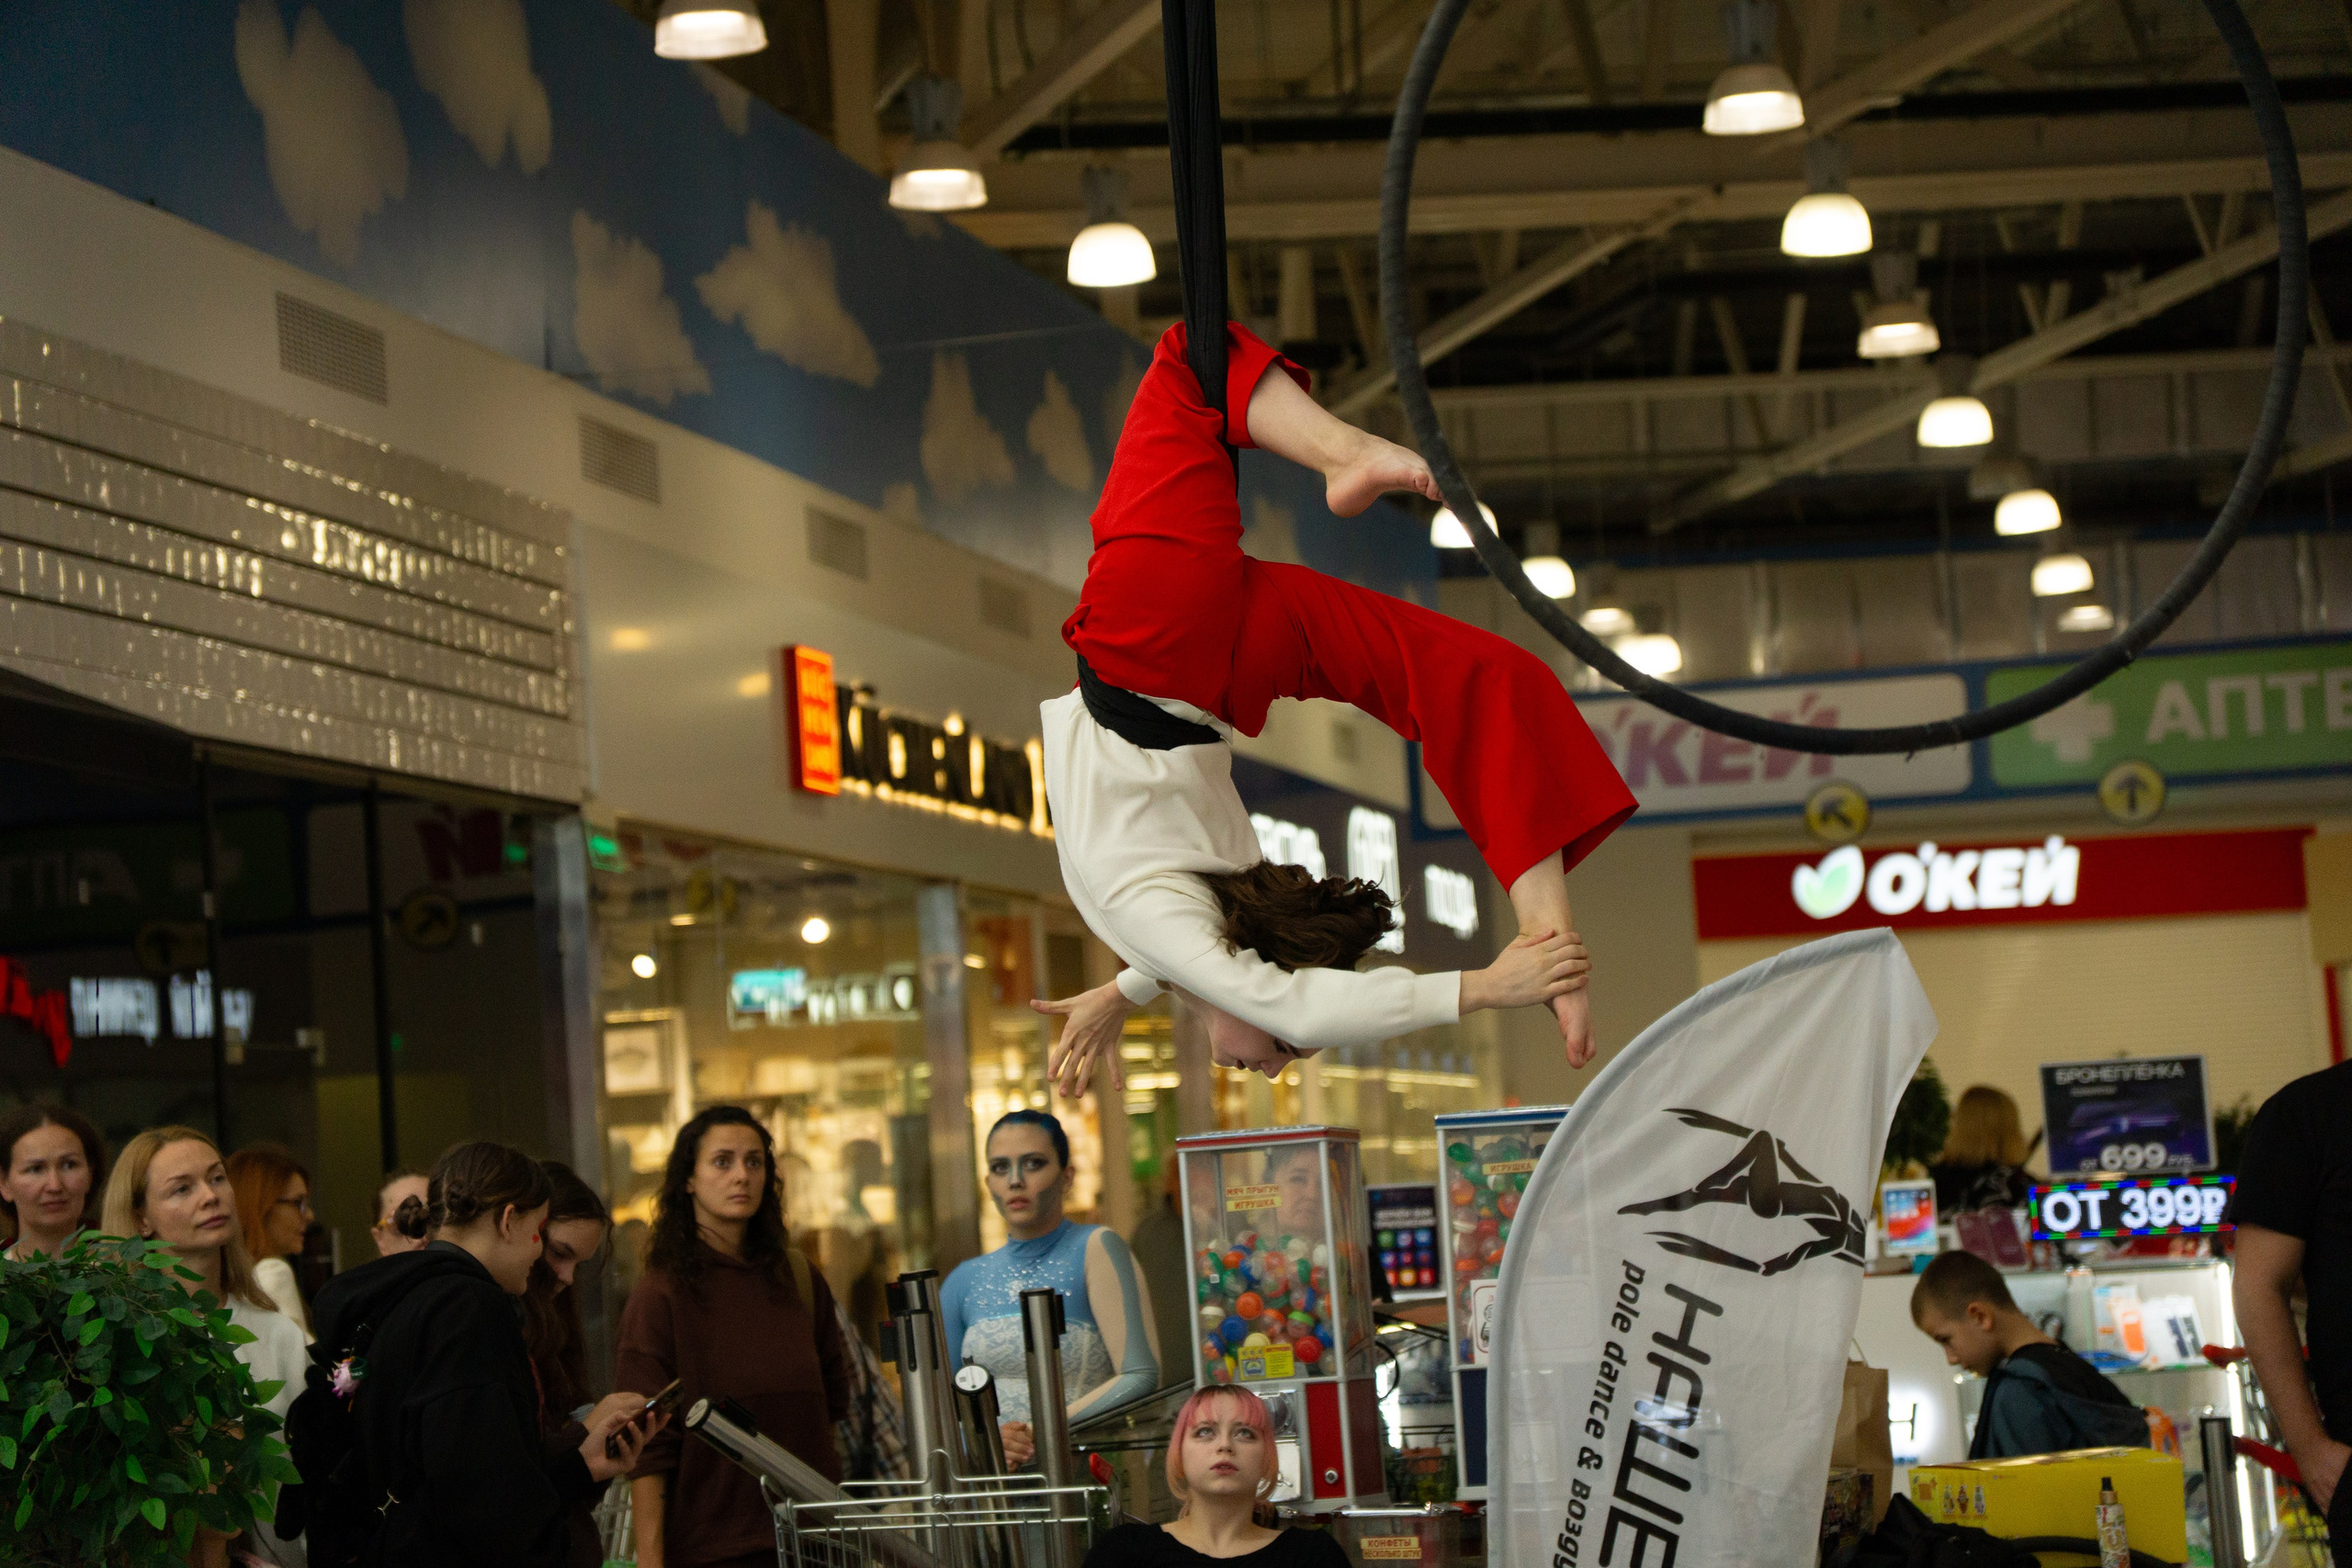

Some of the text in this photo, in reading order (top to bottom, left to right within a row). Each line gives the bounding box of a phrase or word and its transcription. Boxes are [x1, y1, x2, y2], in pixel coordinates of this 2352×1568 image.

[2147, 668, 2352, 742] АПТЕ
[2100, 1142, 2167, 1171] 699
[1235, 1198, 1274, 1210] ИГРУШКА
[2041, 1190, 2110, 1233] ОТ
[1611, 1259, 1645, 1333] pole
[1585, 1341, 1627, 1439] dance
[1577, 1446, 1603, 1471] &
[1367, 1539, 1412, 1548] КОНФЕТЫ
